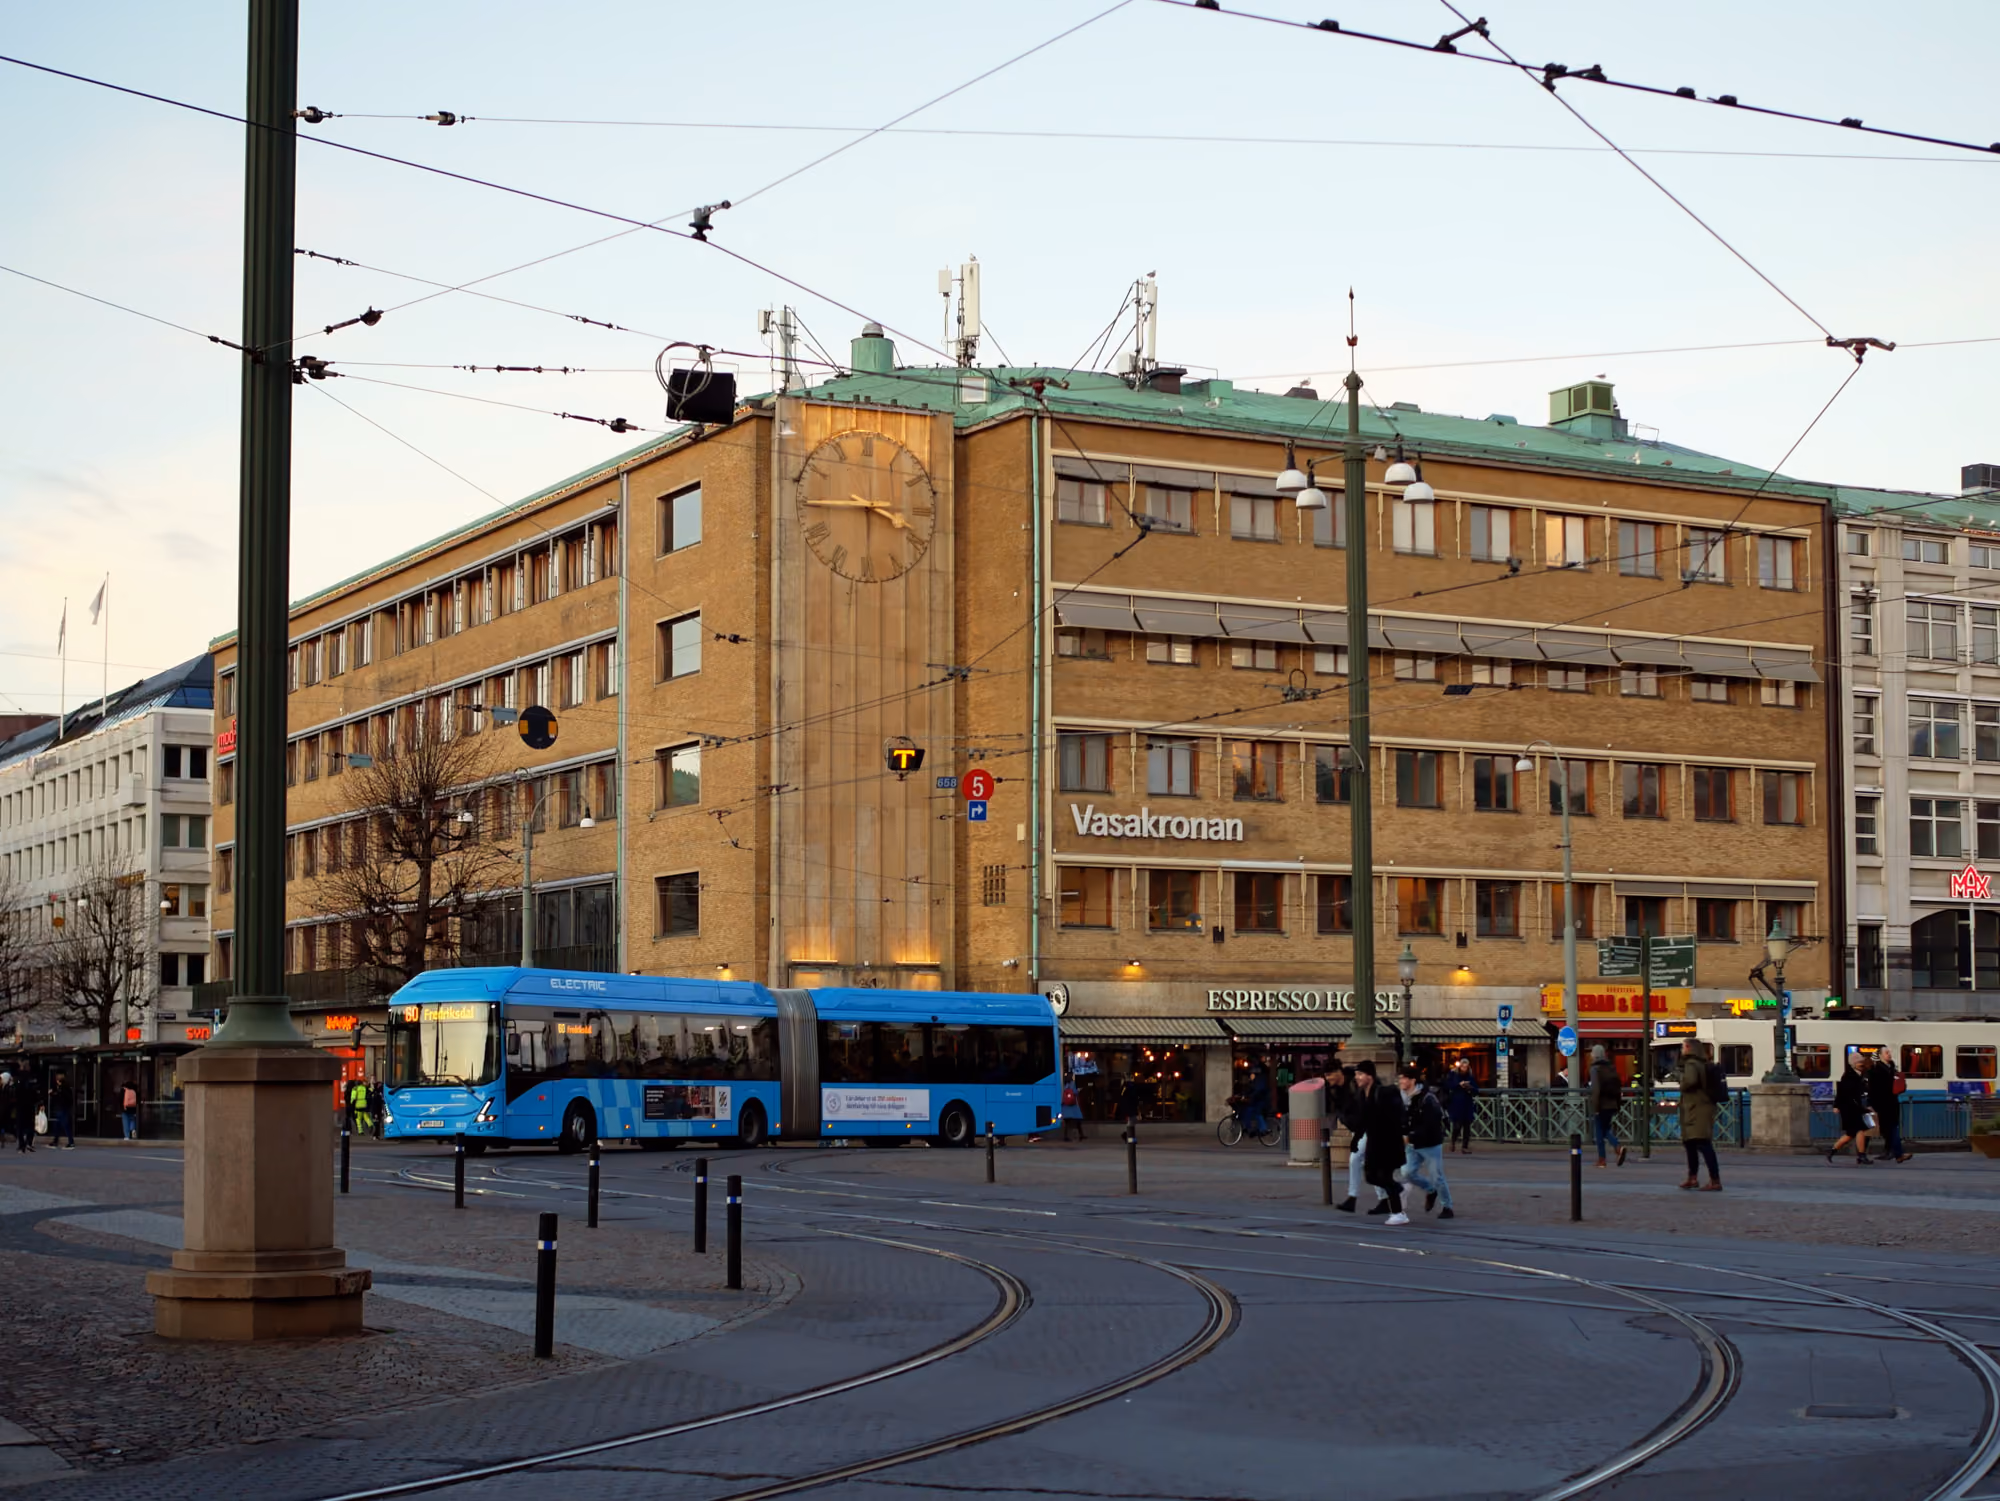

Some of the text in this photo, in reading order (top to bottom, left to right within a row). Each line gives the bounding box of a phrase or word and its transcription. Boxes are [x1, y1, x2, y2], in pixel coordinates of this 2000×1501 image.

[893, 749, 916, 769] T
[937, 777, 957, 788] 658
[972, 776, 984, 797] 5
[1070, 803, 1244, 841] Vasakronan
[1951, 864, 1992, 899] MAX
[550, 978, 607, 991] ELECTRIC
[1207, 989, 1401, 1012] ESPRESSO HOSE
[404, 1005, 475, 1022] 60 Fredriksdal
